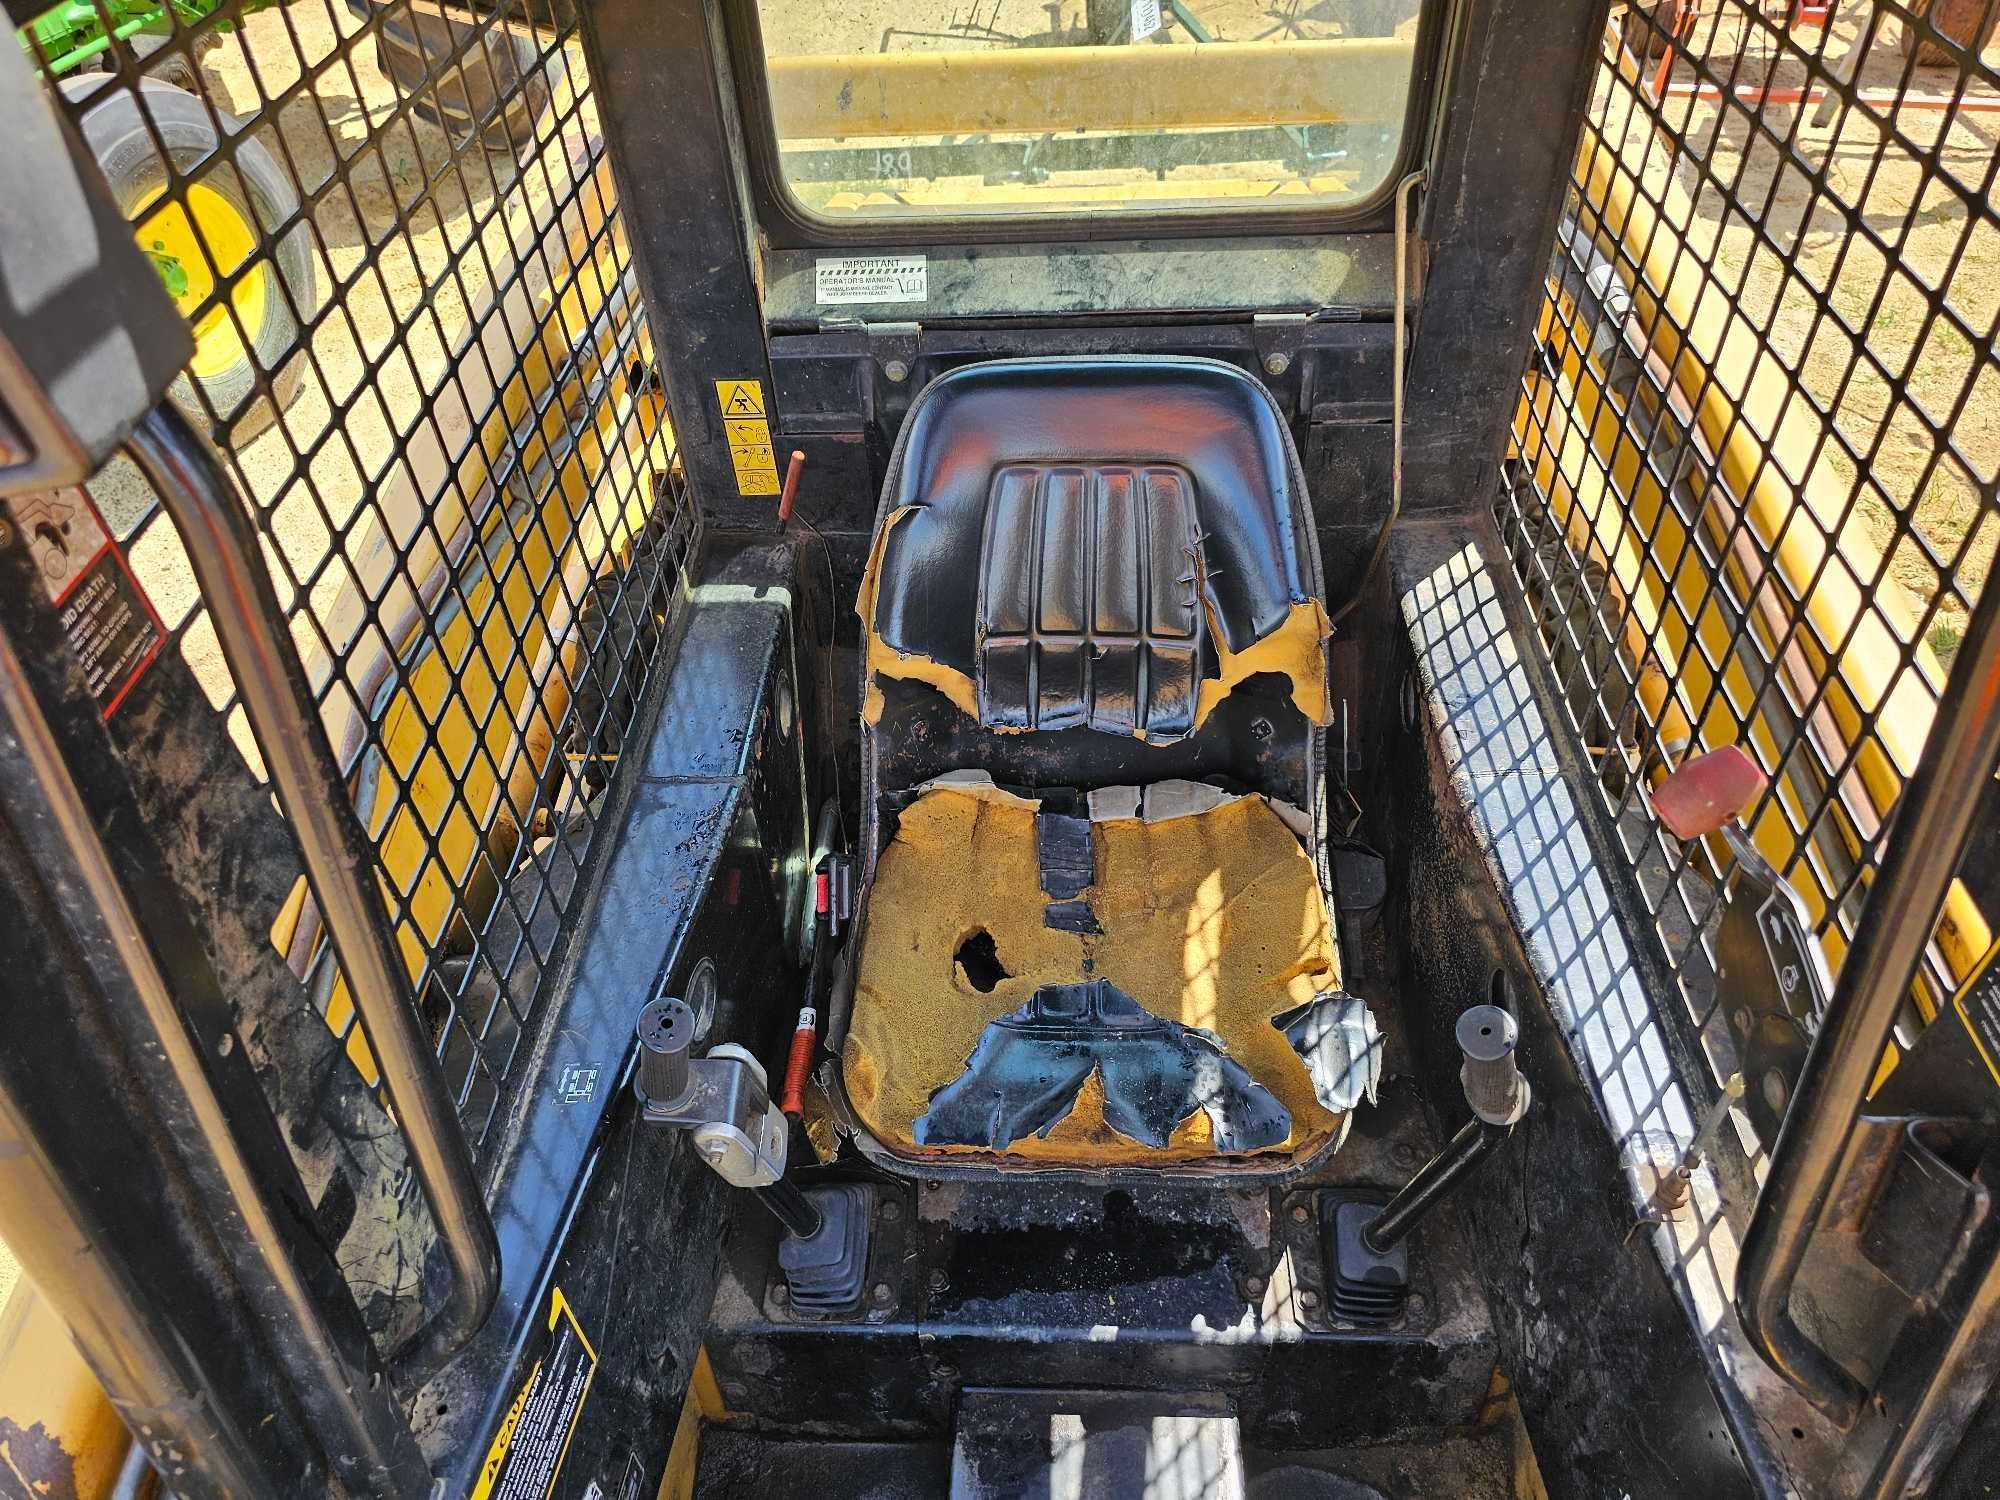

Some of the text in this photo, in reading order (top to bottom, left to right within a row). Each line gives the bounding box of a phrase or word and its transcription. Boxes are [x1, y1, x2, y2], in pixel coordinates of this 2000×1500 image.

[841, 258, 900, 268] IMPORTANT
[865, 275, 894, 283] MANUAL
[74, 572, 106, 613] DEATH
[100, 623, 110, 637] TO
[510, 1366, 543, 1451] AVOID INJURY
[524, 1392, 539, 1430] MANUAL
[509, 1438, 527, 1484] LOCATION
[525, 1420, 534, 1441] AND
[532, 1380, 549, 1423] FUNCTION
[530, 1435, 538, 1457] AND
[534, 1437, 543, 1460] AND
[511, 1456, 525, 1492] SAFETY
